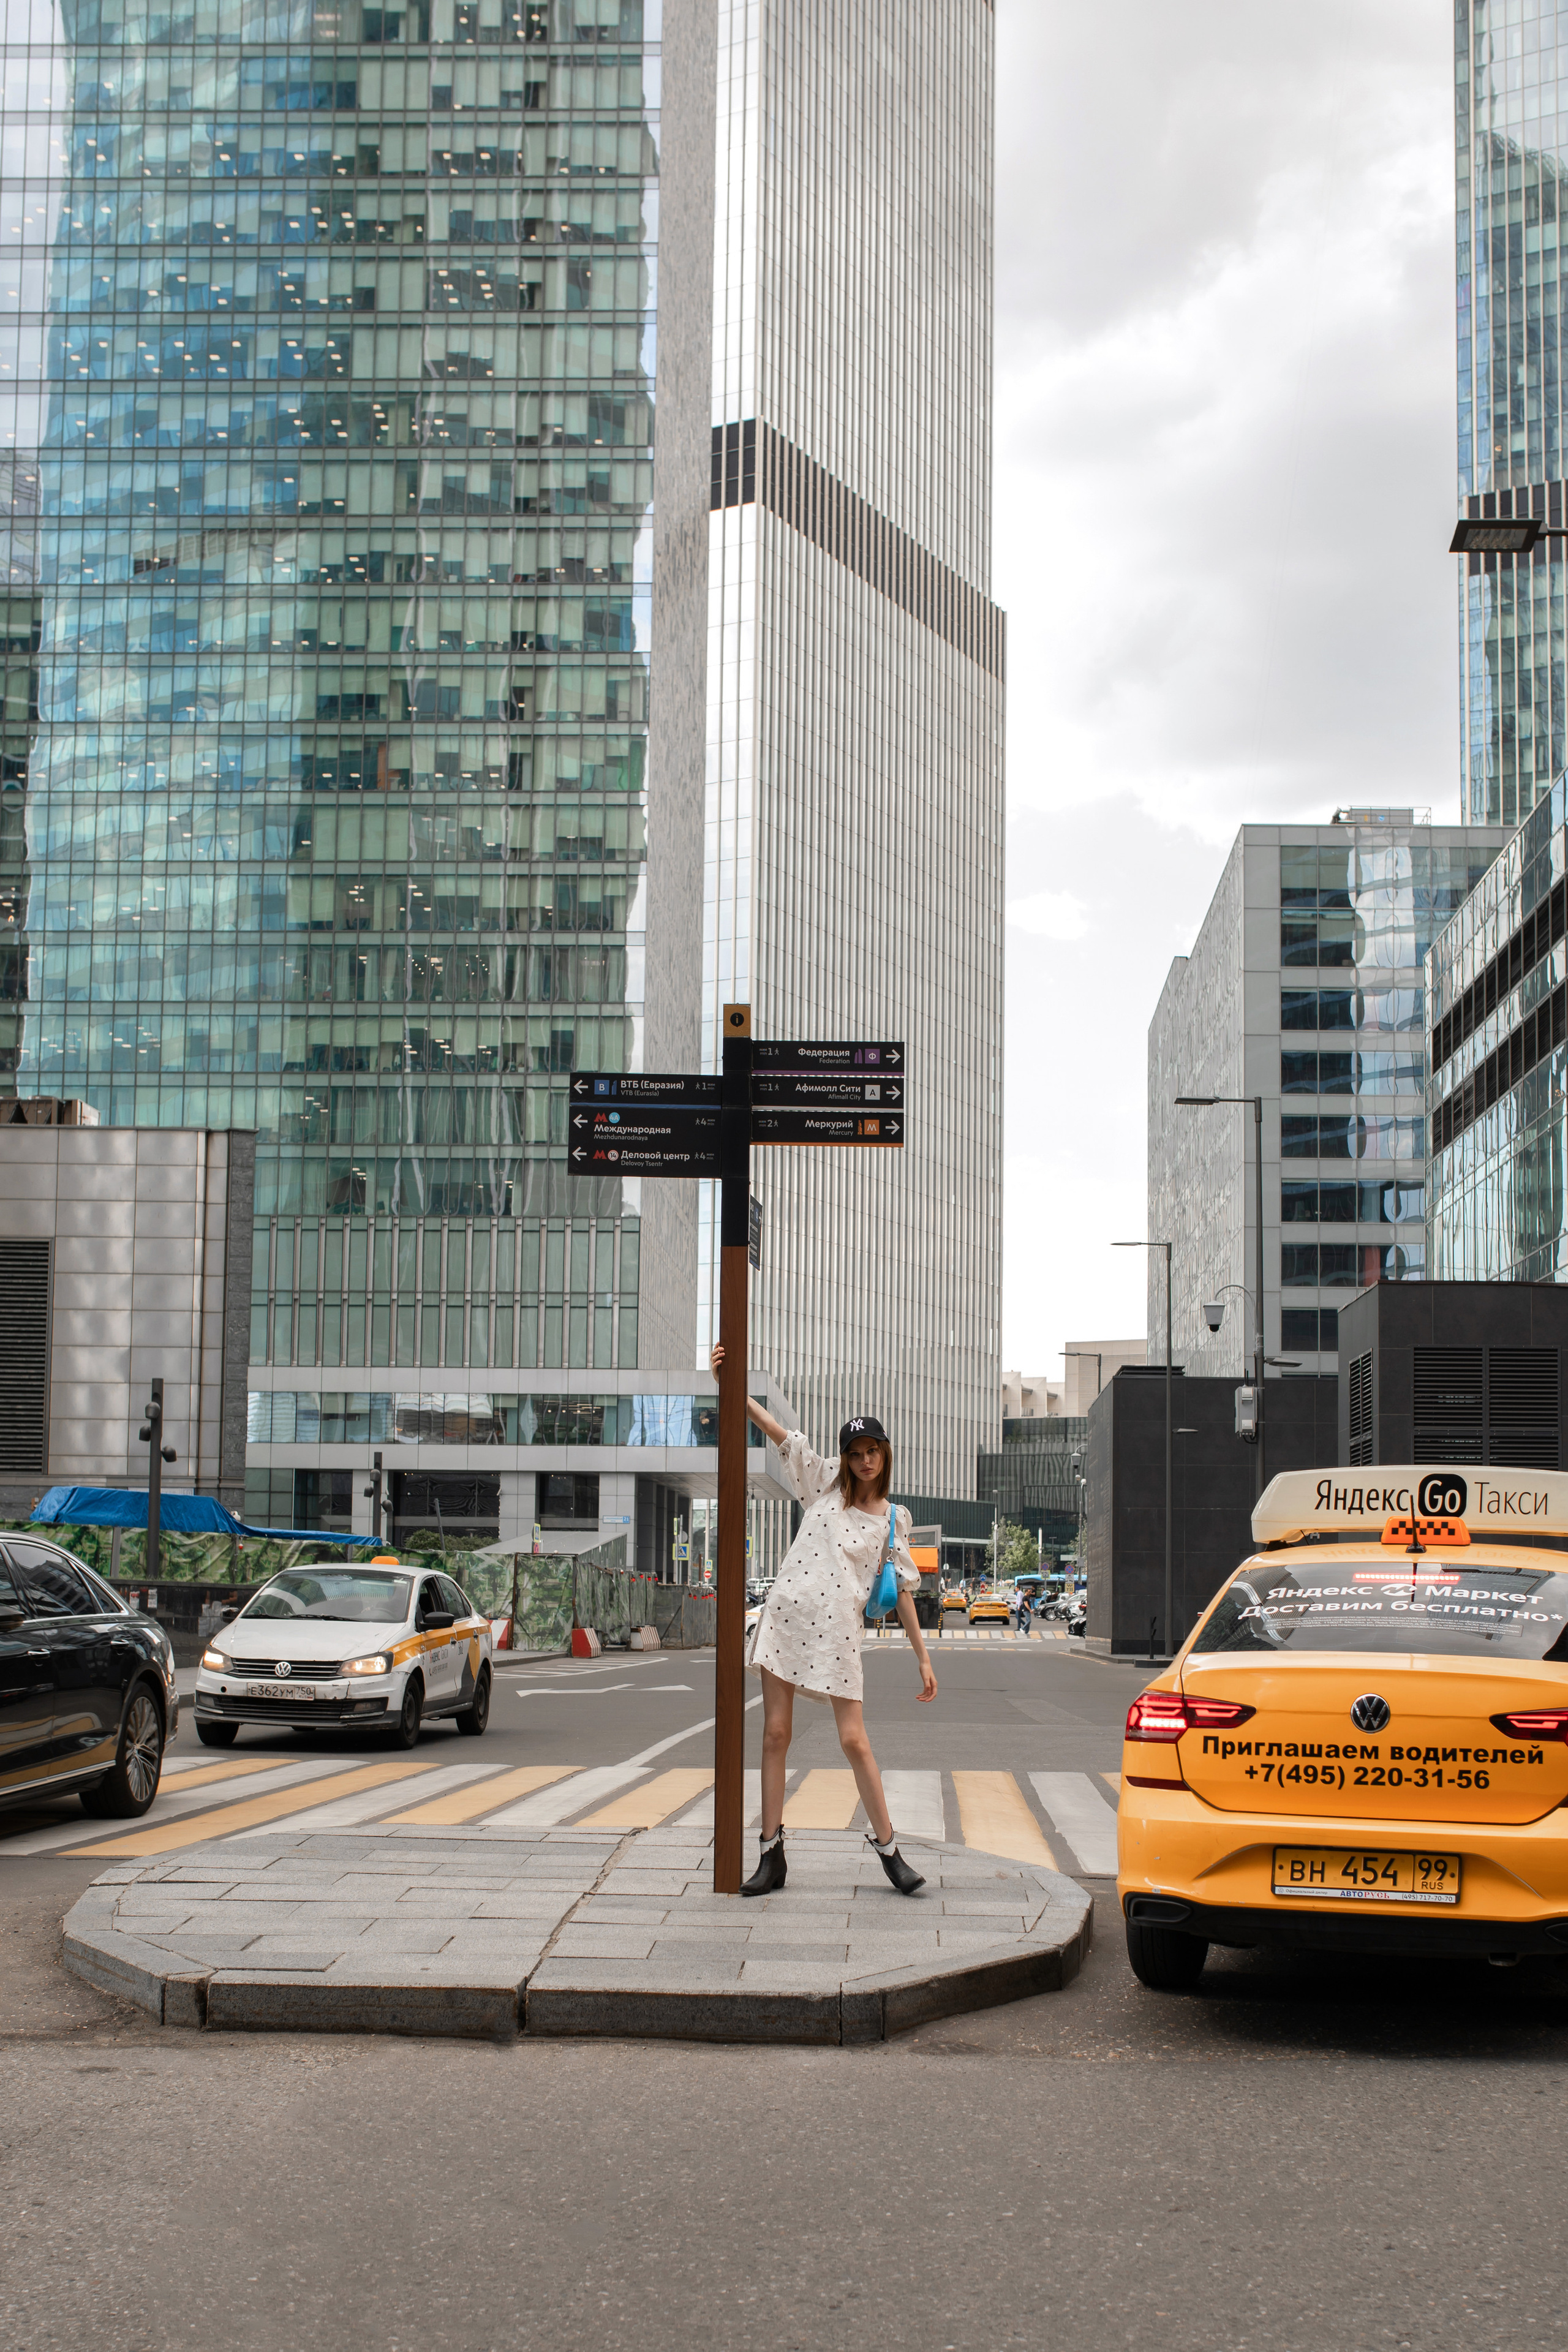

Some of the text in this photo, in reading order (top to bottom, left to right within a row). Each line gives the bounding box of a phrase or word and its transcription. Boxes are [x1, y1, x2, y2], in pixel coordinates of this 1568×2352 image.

[798, 1048, 850, 1057] Федерация
[641, 1080, 685, 1090] (Евразия)
[795, 1084, 837, 1093] Афимолл
[594, 1124, 671, 1134] Международная
[767, 1119, 773, 1128] 2
[805, 1120, 853, 1129] Меркурий
[620, 1150, 661, 1160] Деловой
[663, 1152, 690, 1161] центр
[850, 1419, 865, 1432] NY
[1314, 1480, 1548, 1516] Яндекс Go Такси
[1266, 1584, 1544, 1605] Яндекс Маркет
[1238, 1600, 1383, 1620] Доставим
[295, 1686, 311, 1695] 750
[1202, 1735, 1544, 1765] Приглашаем водителей
[1245, 1763, 1490, 1790] +7(495) 220-31-56
[1289, 1855, 1448, 1887] ВН 454 99
[1421, 1880, 1444, 1890] RUS
[1340, 1890, 1390, 1899] АВТОРУСЬ
[1401, 1893, 1419, 1901] (495)
